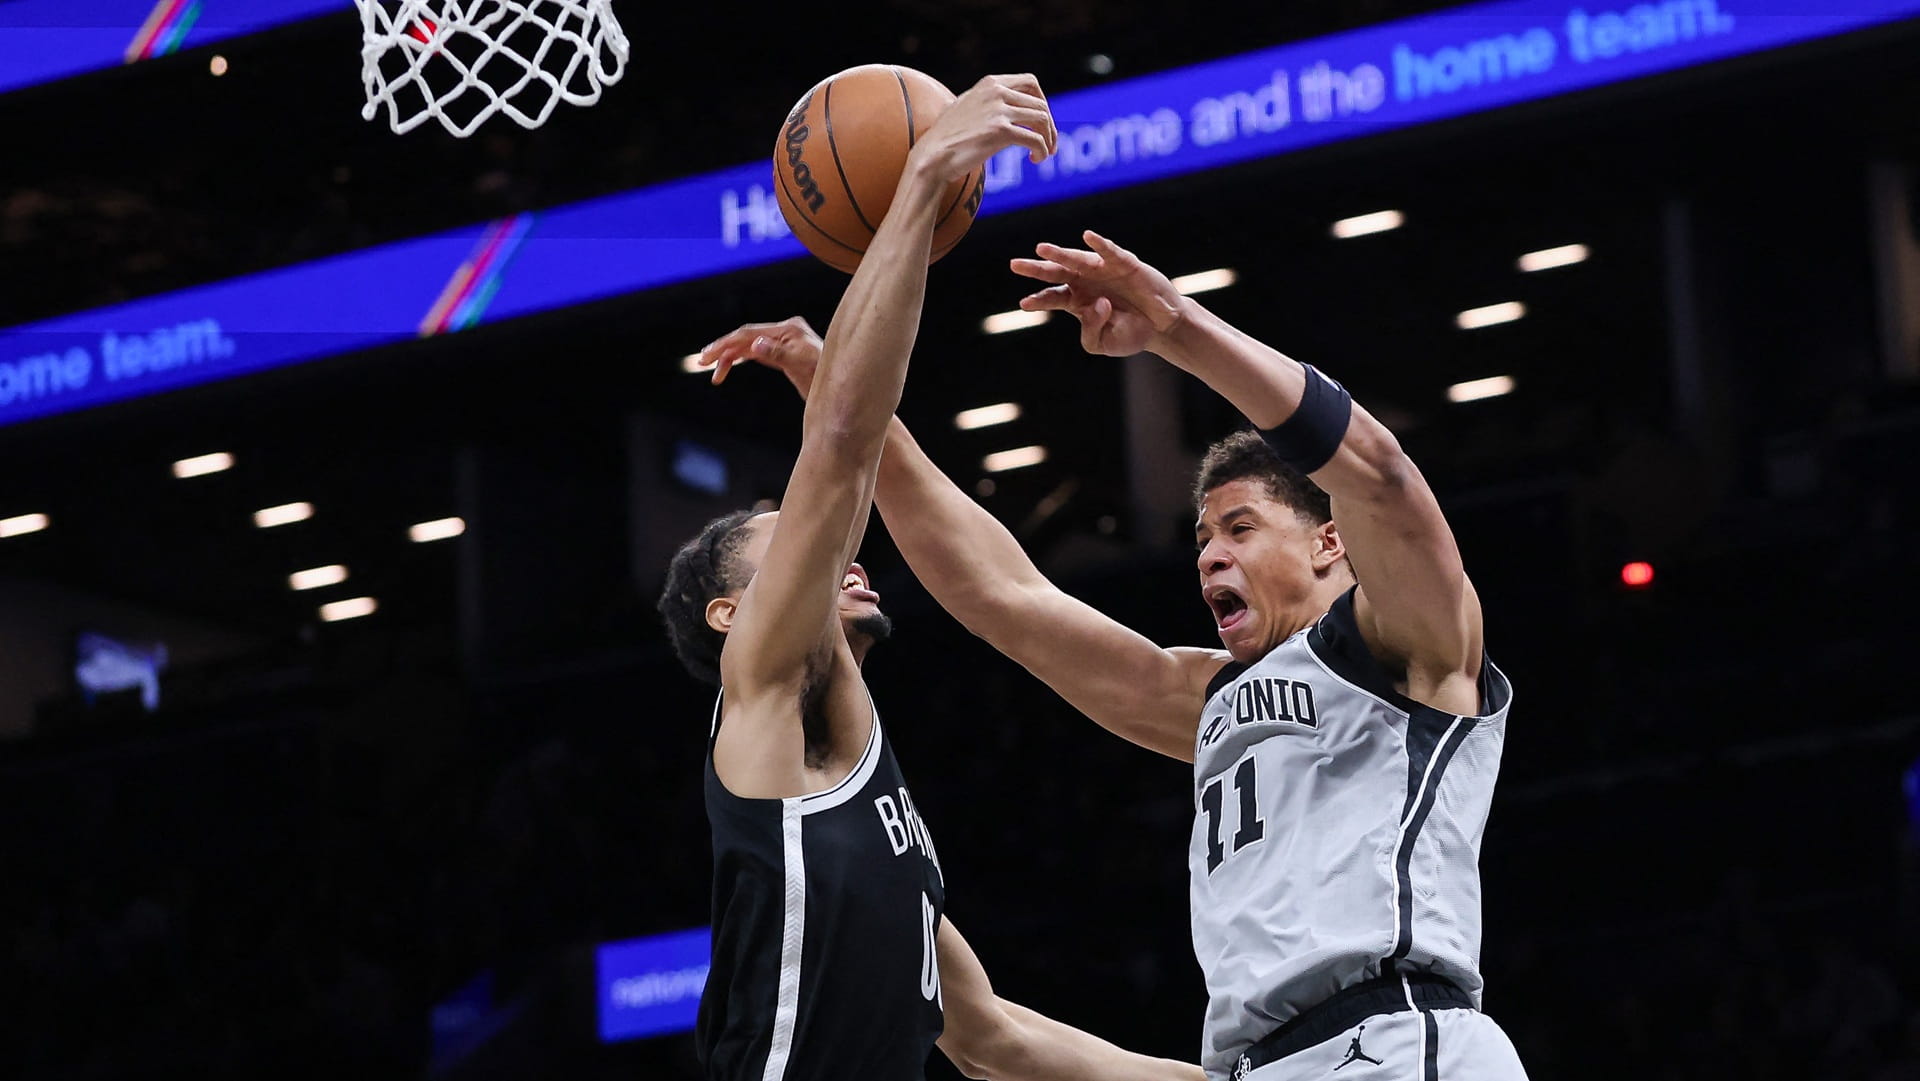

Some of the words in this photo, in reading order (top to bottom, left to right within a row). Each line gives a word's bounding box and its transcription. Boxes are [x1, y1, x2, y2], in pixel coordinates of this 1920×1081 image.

[1190, 68, 1291, 147] and
[1298, 58, 1386, 123] the
[1392, 26, 1557, 102] home
[1200, 752, 1267, 878] 11
